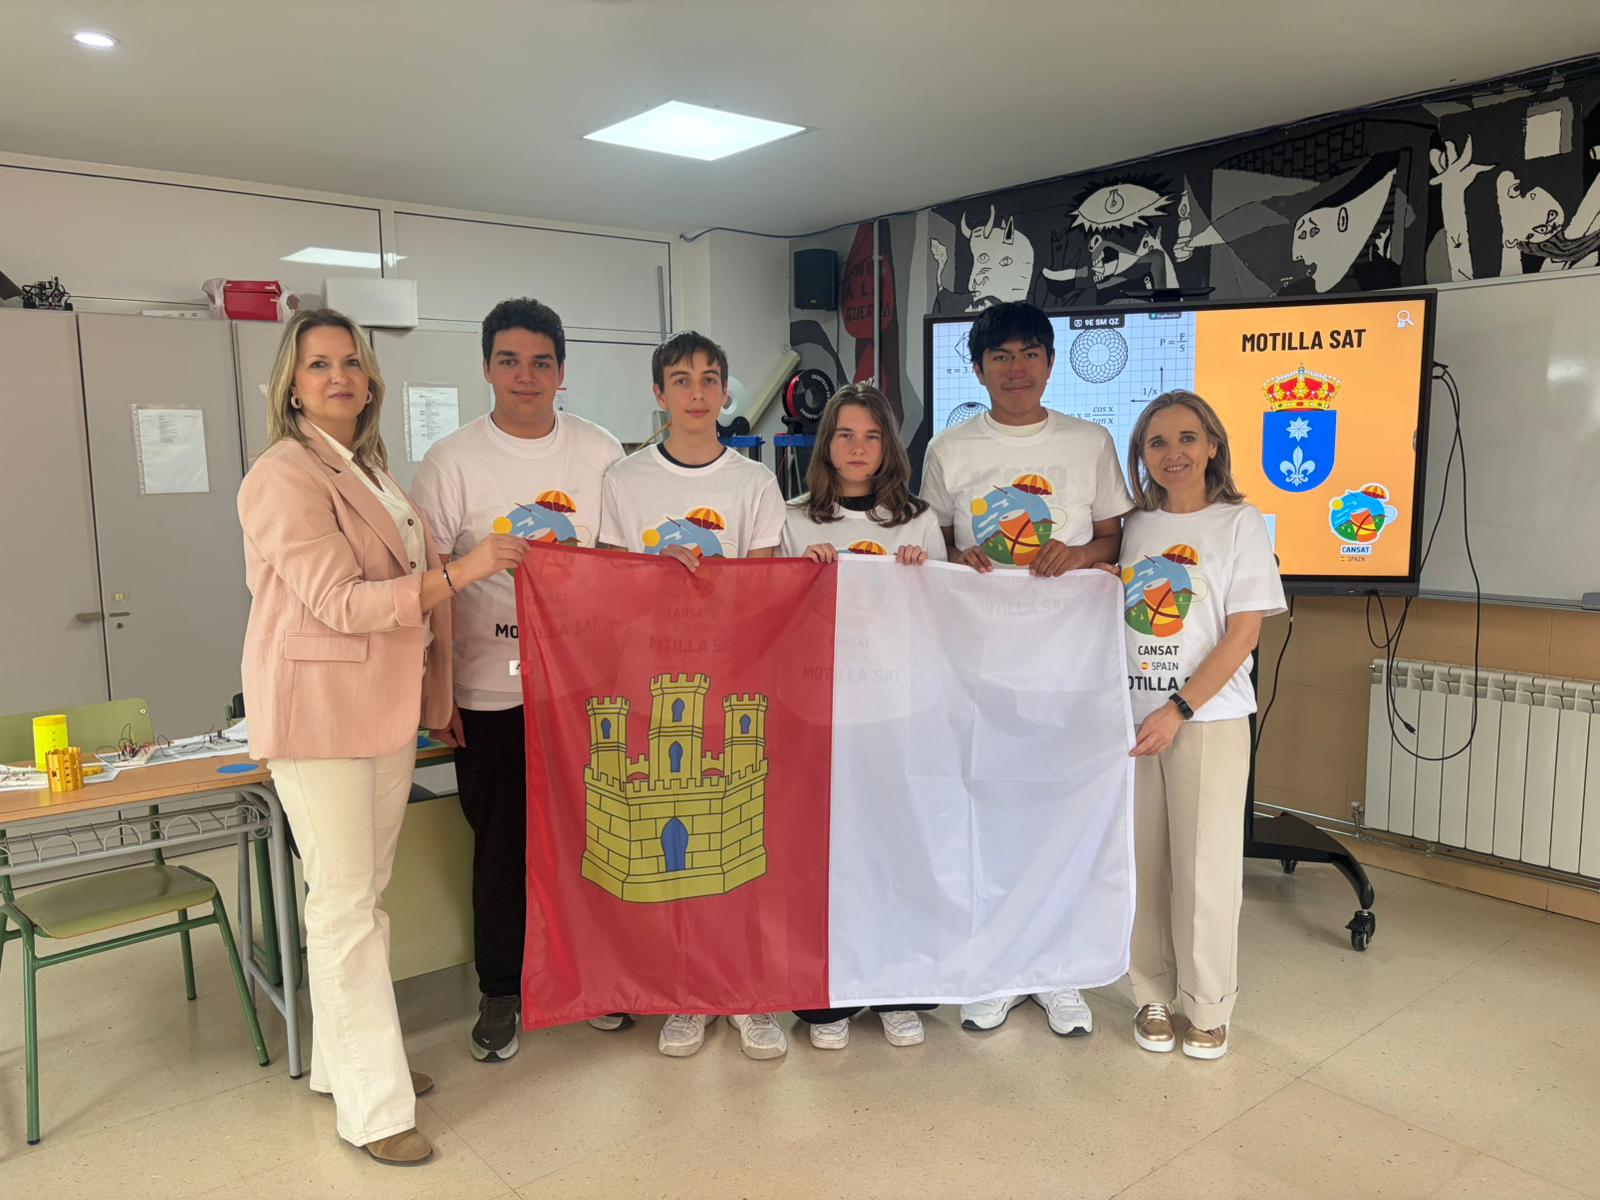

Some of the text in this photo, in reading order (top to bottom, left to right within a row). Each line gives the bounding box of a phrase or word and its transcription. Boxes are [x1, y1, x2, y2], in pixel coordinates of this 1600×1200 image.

[1084, 317, 1120, 327] 9E SM QZ
[1179, 332, 1186, 340] F
[1241, 328, 1367, 353] MOTILLA SAT
[1160, 338, 1166, 347] P
[1179, 344, 1186, 353] S
[1143, 387, 1158, 397] 1/x
[1341, 546, 1370, 554] CANSAT
[1137, 645, 1180, 656] CANSAT
[1151, 661, 1179, 671] SPAIN
[1128, 675, 1179, 692] OTILLA
